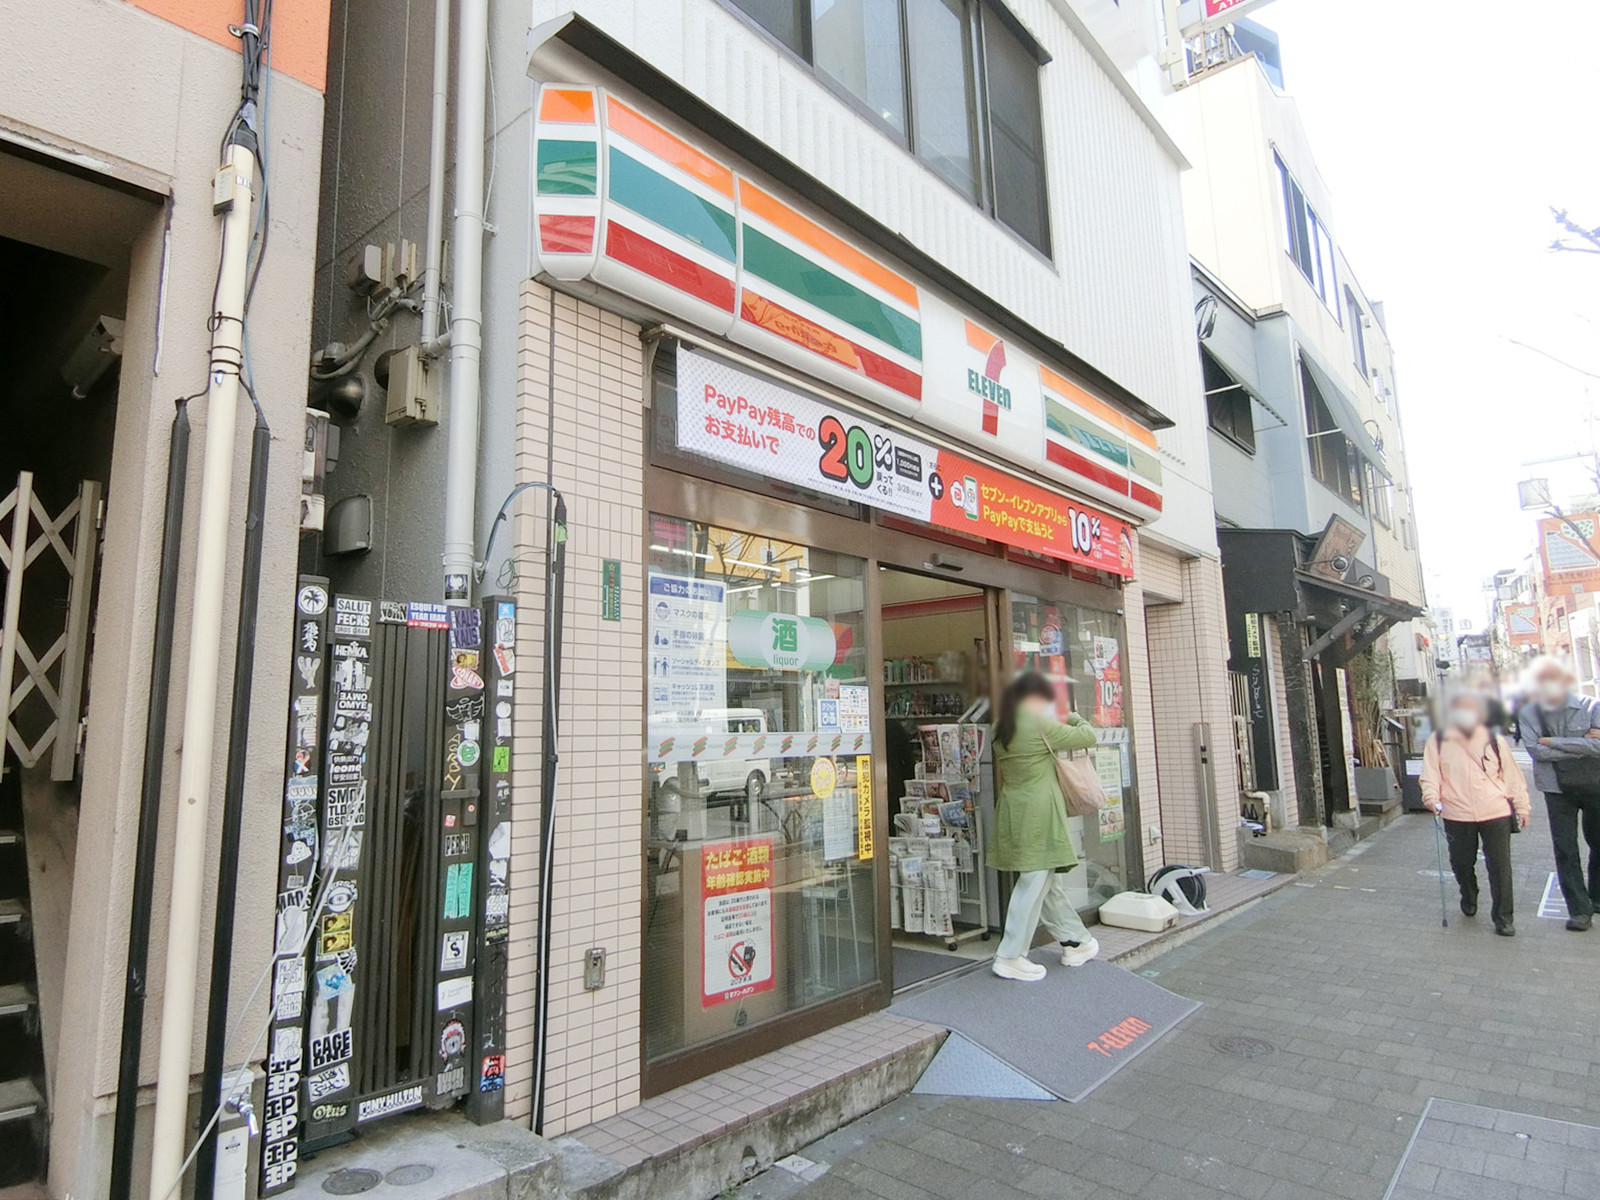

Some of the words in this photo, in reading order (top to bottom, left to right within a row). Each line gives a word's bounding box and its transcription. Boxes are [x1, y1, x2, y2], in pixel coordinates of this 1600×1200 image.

[704, 383, 816, 441] PayPay残高での
[704, 414, 781, 456] お支払いで
[818, 415, 893, 490] 20%
[982, 505, 1055, 541] PayPayで支払うと
[1067, 506, 1101, 556] 10%
[337, 600, 371, 613] SALUT
[772, 617, 798, 652] 酒
[773, 653, 799, 667] liquor
[338, 700, 368, 710] OMYE
[705, 868, 771, 890] 年齢確認実施中
[312, 1030, 351, 1058] CAGE
[312, 1048, 351, 1069] ONE
